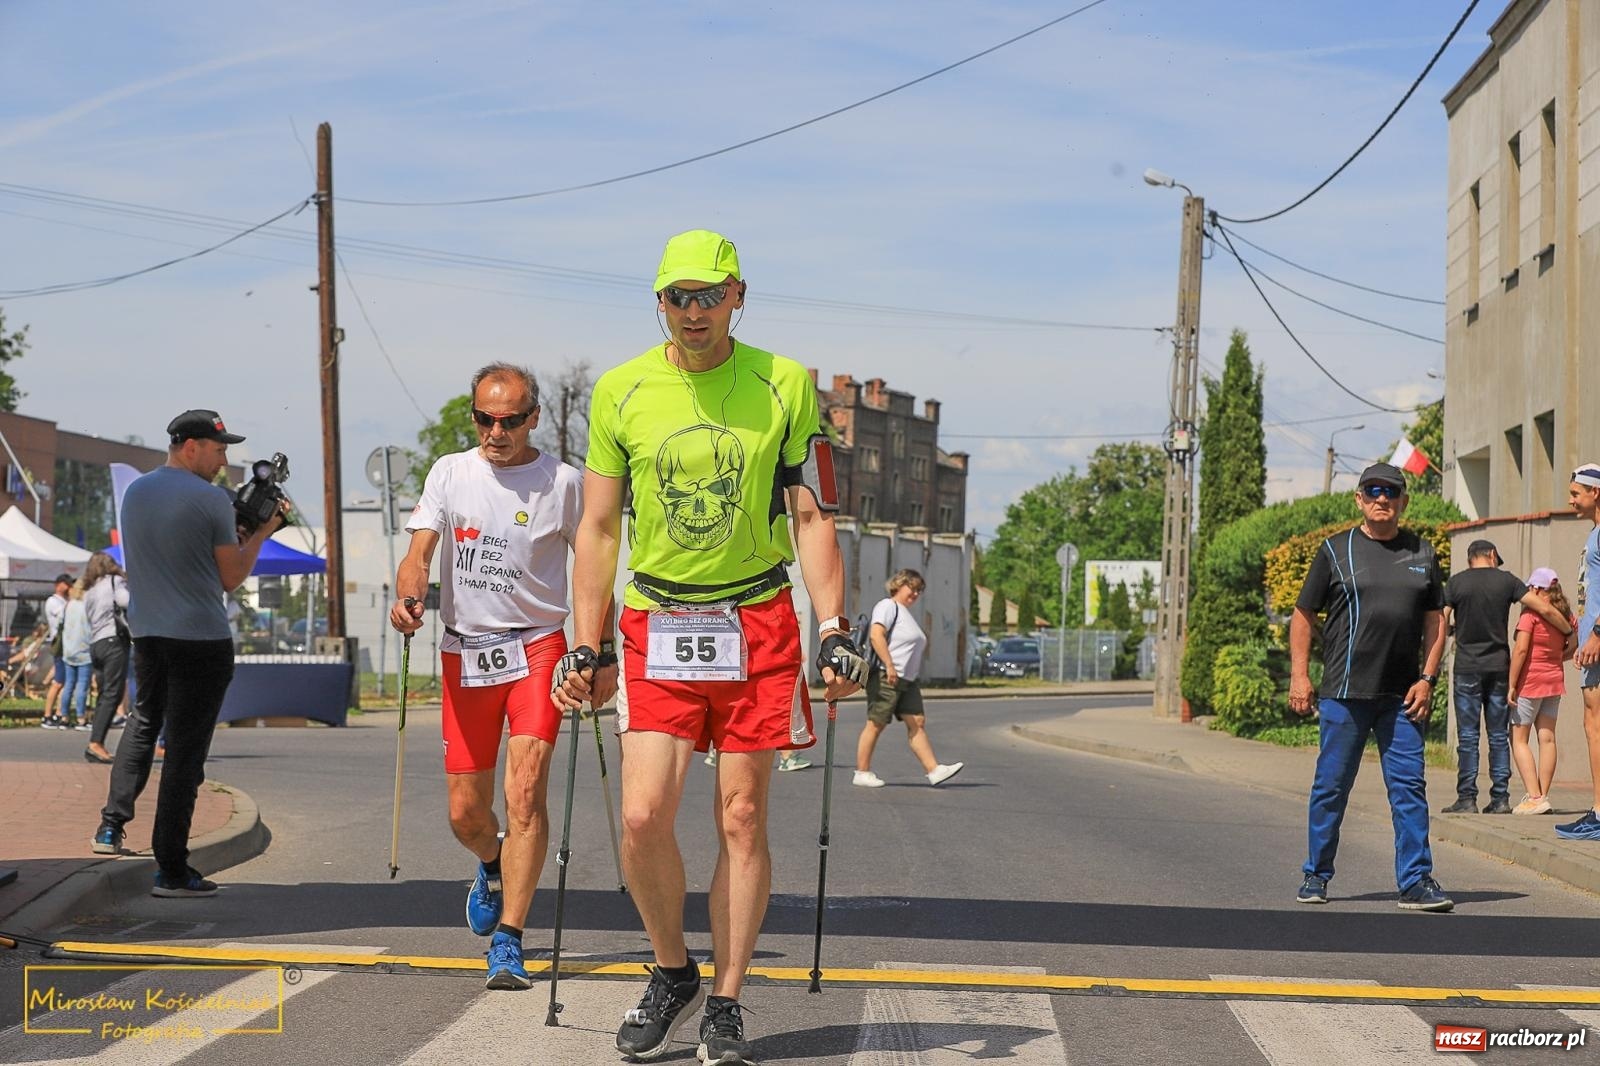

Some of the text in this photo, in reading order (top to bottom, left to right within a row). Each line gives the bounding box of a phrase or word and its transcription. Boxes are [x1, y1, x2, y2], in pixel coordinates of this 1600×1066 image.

[482, 534, 508, 549] BIEG
[456, 544, 476, 573] XII
[480, 551, 503, 562] BEZ
[479, 564, 523, 580] GRANIC
[458, 576, 515, 594] 3 MAJA 2019
[675, 636, 717, 663] 55
[477, 648, 508, 673] 46
